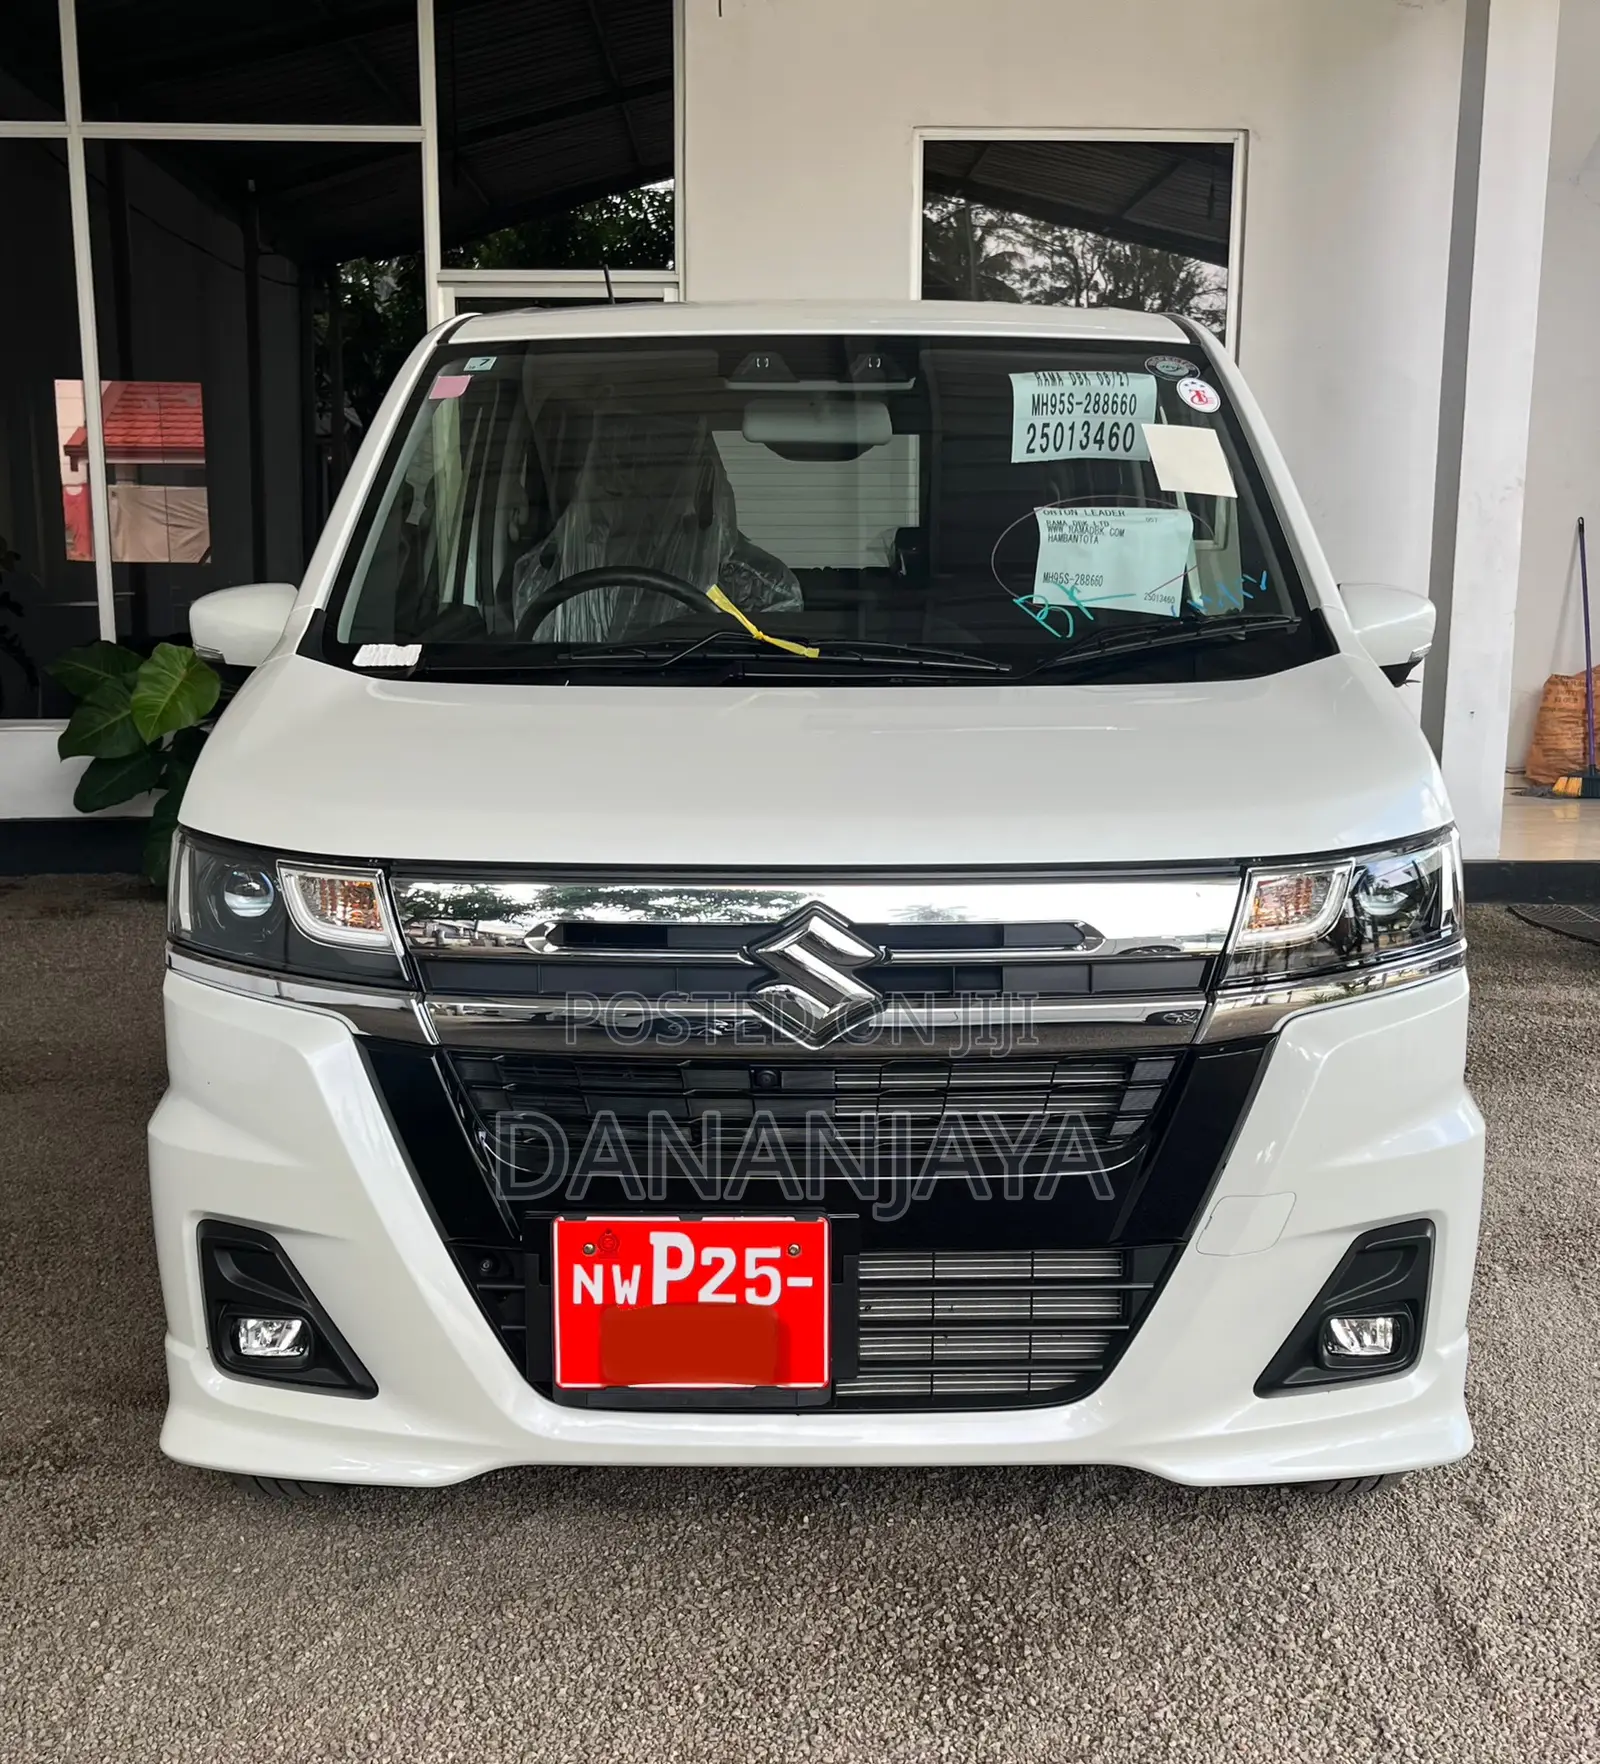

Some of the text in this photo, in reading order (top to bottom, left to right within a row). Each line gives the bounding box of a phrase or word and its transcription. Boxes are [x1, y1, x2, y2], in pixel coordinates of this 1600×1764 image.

[1034, 371, 1064, 387] RAMA
[1069, 371, 1091, 387] DBK
[1031, 392, 1137, 417] MH95S-288660
[1025, 420, 1135, 455] 25013460
[1042, 572, 1104, 587] MH95S-288660
[572, 1263, 641, 1305] NW
